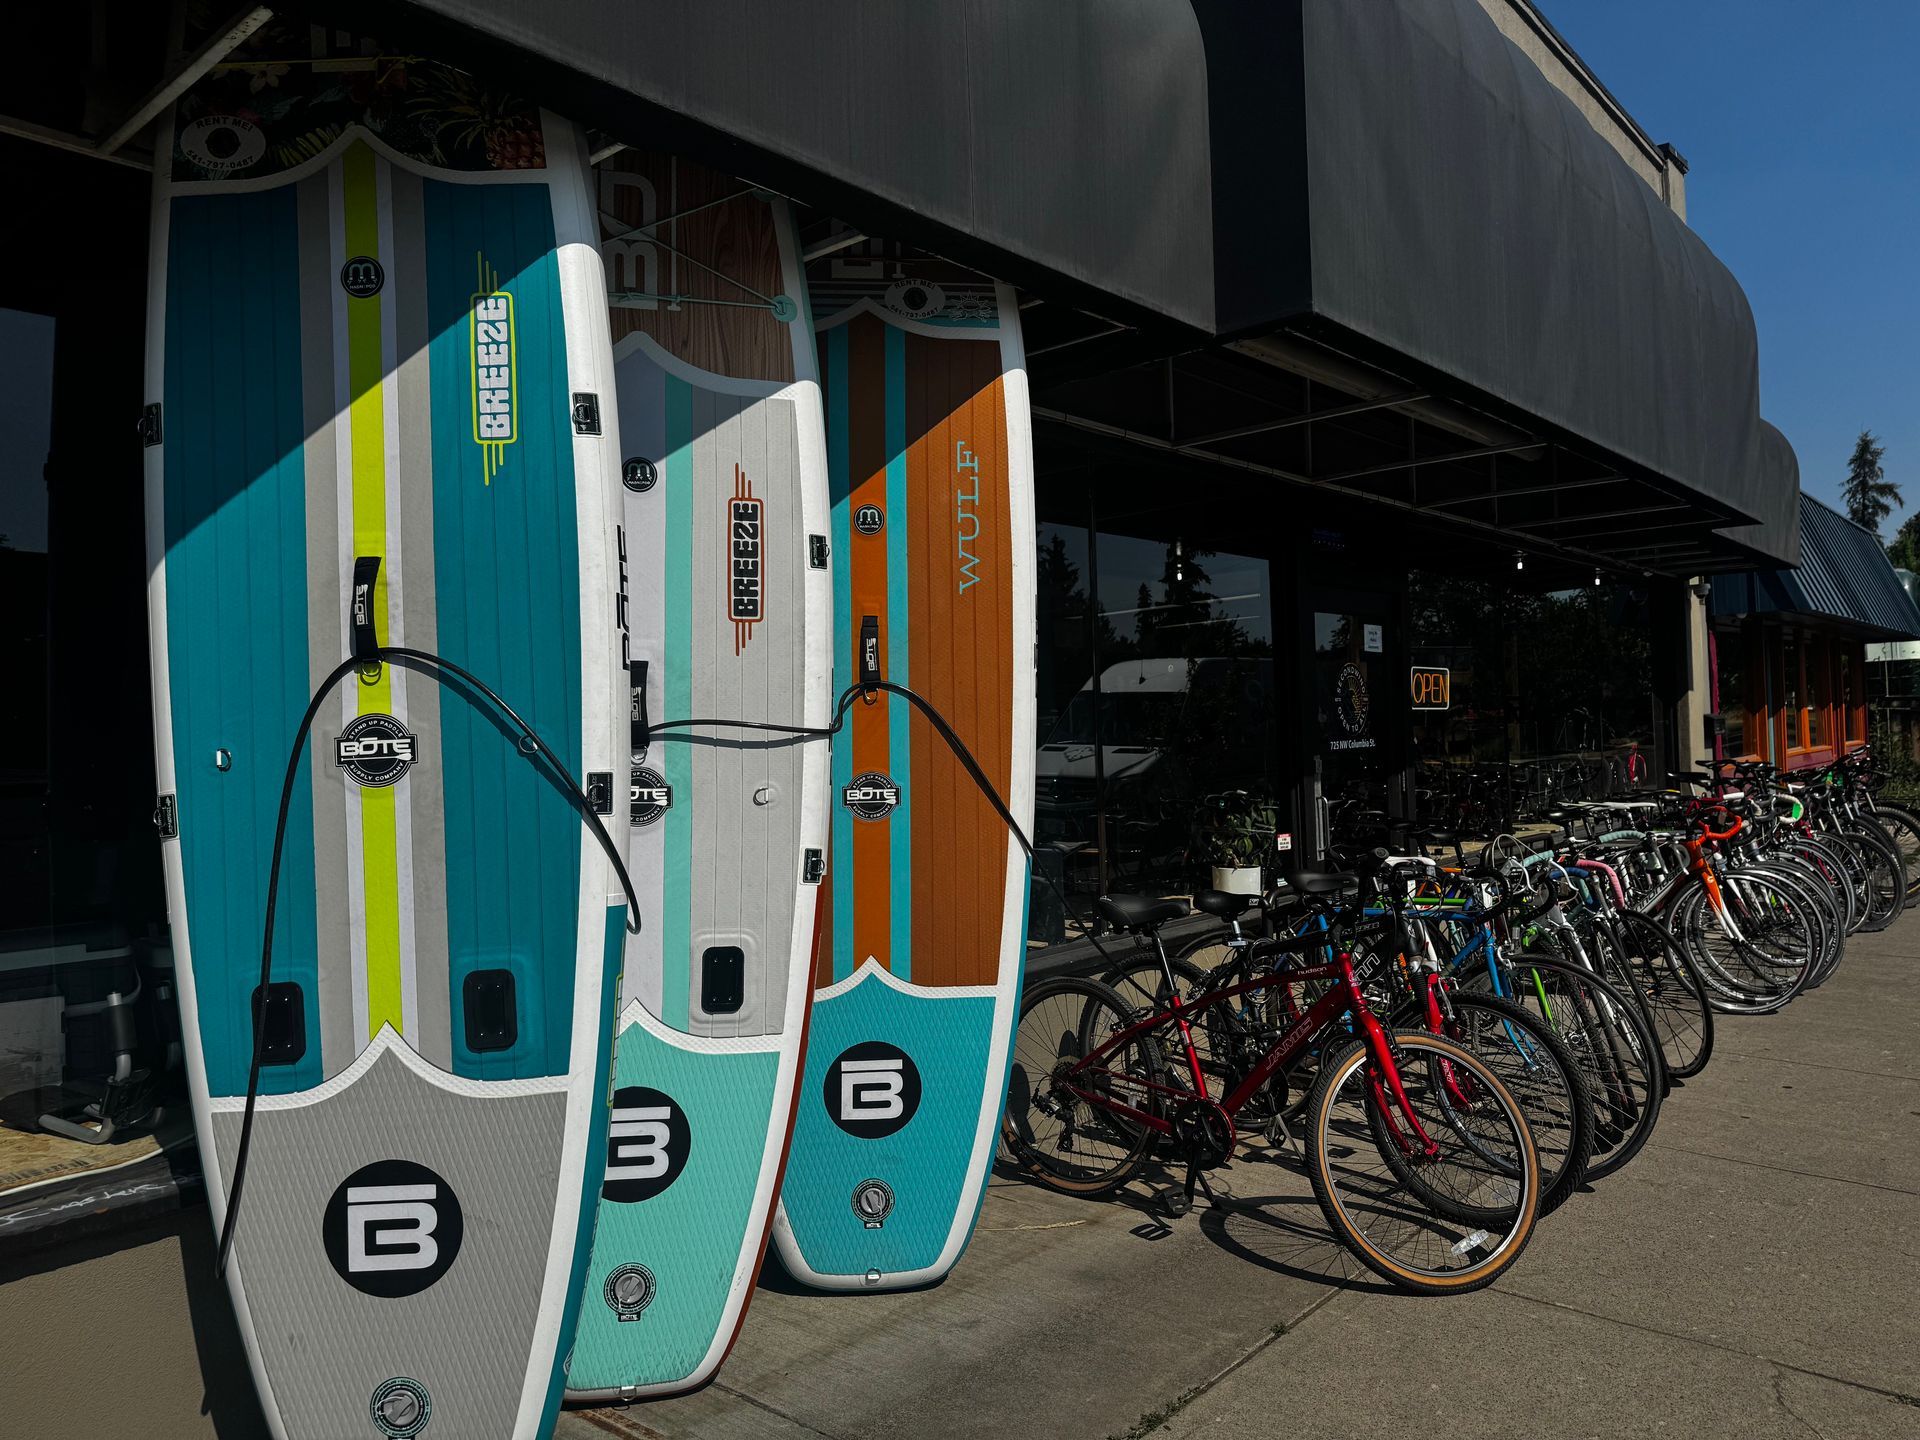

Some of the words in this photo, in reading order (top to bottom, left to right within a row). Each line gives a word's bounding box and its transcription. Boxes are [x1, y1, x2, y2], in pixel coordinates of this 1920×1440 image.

[195, 117, 229, 128] RENT
[232, 119, 253, 132] ME!
[476, 298, 511, 438] BREEZE
[957, 441, 981, 595] WULF
[733, 503, 758, 617] BREEZE
[1412, 672, 1448, 704] OPEN
[348, 722, 367, 740] STAND
[380, 720, 404, 737] PADDLE
[1330, 740, 1340, 750] 725
[350, 764, 373, 780] SUPPLY
[375, 761, 404, 781] COMPANY
[1297, 966, 1328, 976] hudson
[1265, 1017, 1313, 1071] JAMIS
